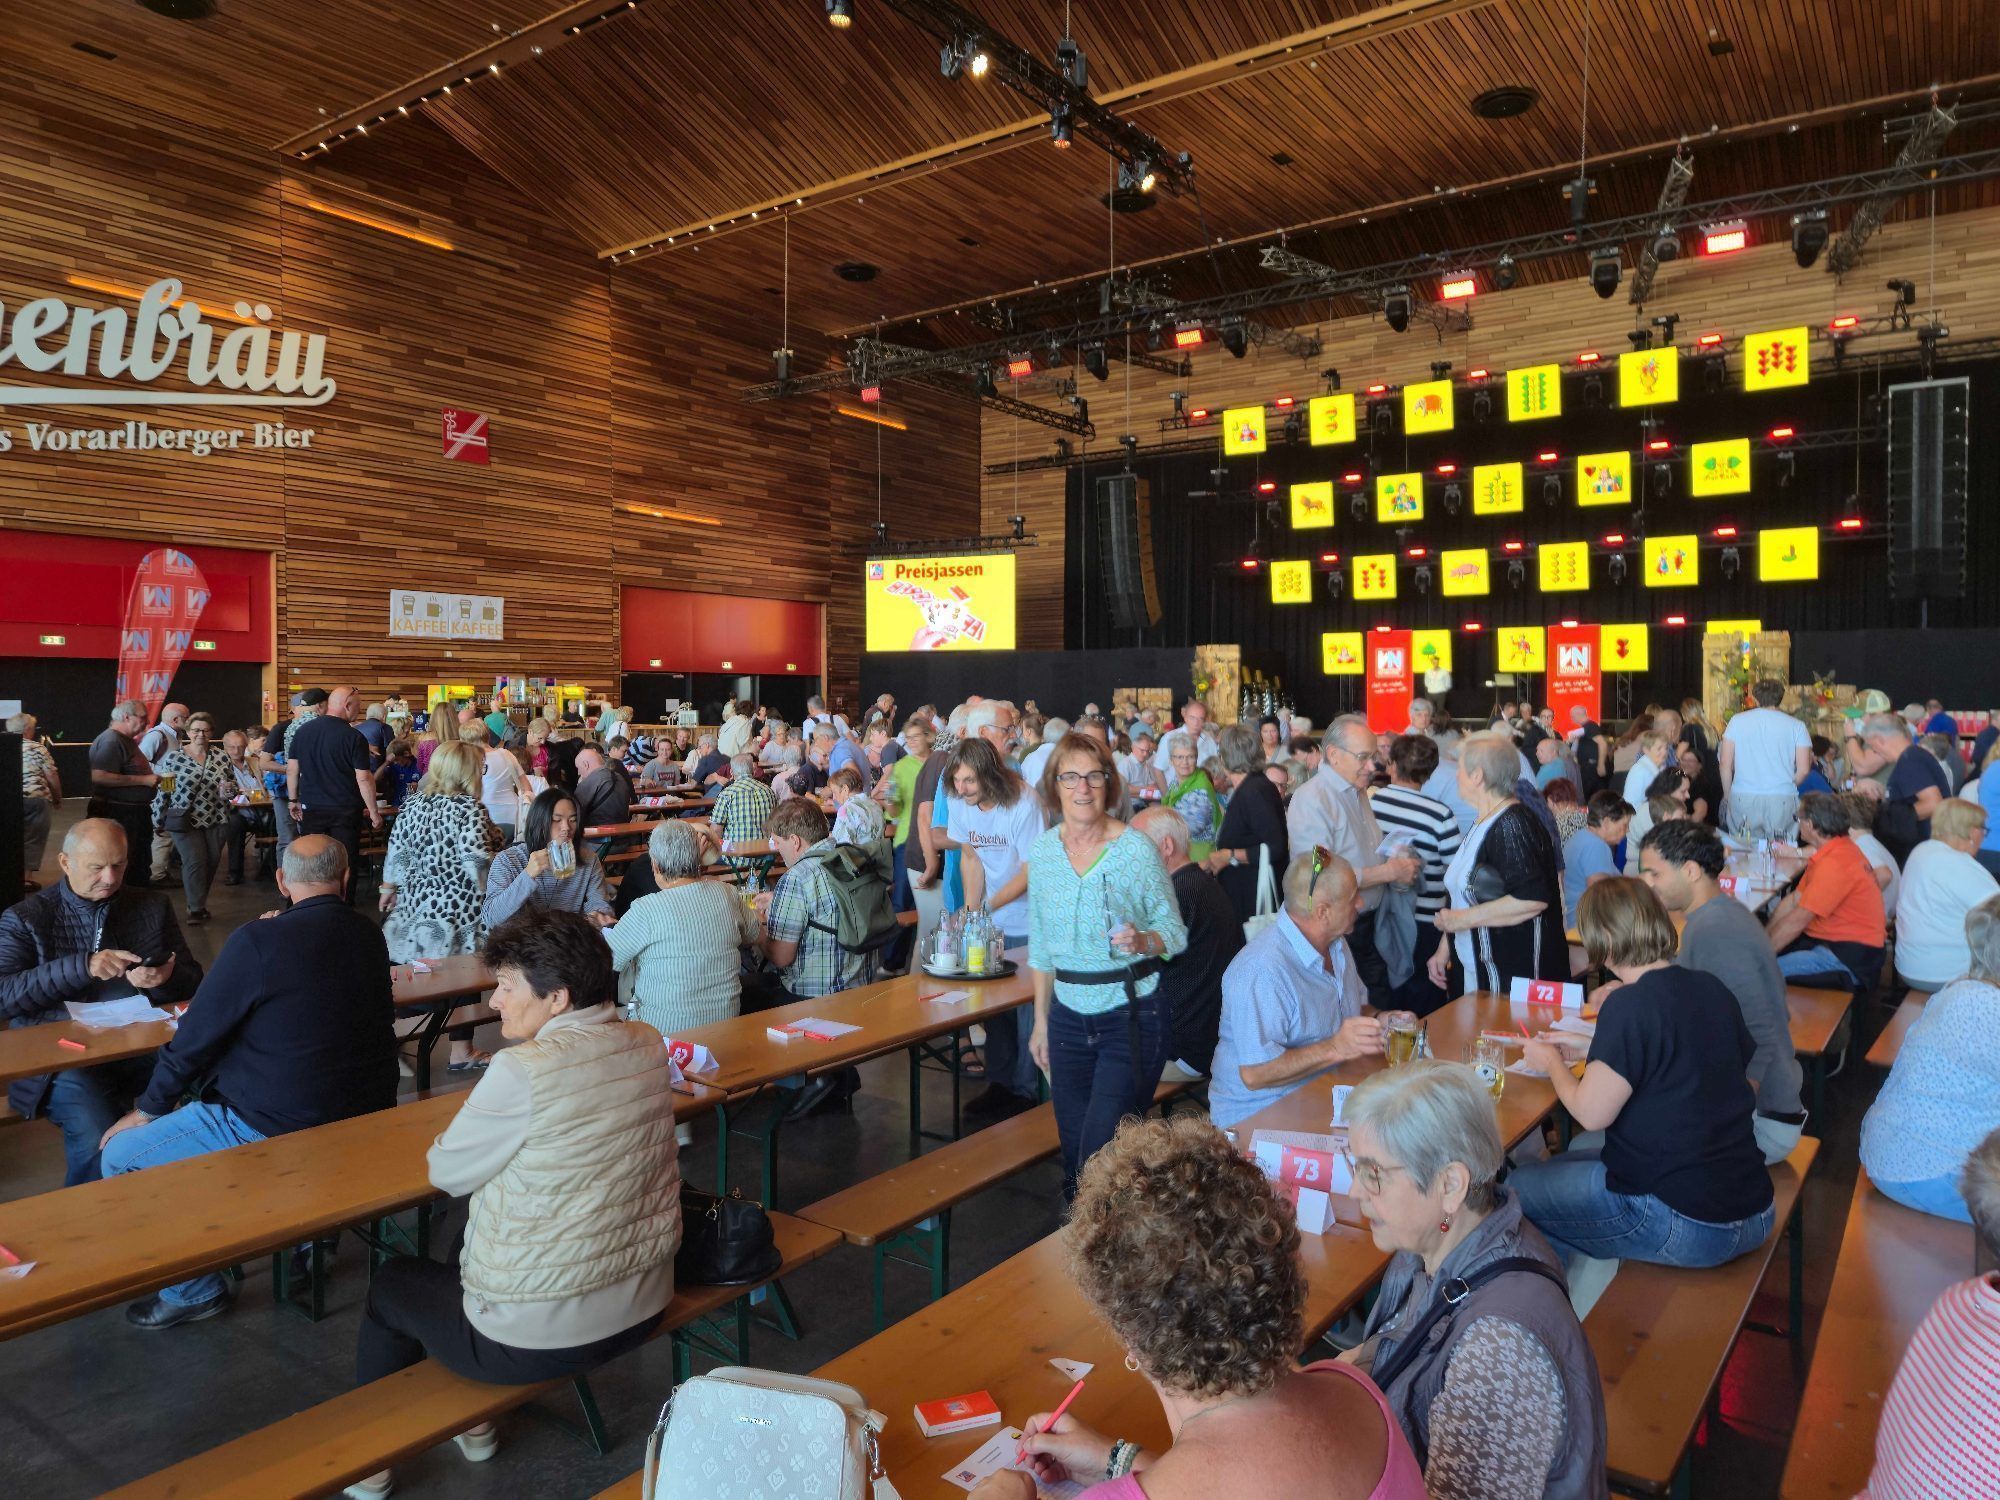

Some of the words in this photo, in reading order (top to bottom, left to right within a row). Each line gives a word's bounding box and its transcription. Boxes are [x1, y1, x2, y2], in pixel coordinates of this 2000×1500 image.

[0, 278, 337, 405] enbräu
[25, 421, 243, 456] Vorarlberger
[254, 422, 315, 449] Bier
[895, 562, 983, 581] Preisjassen
[143, 585, 171, 608] VN
[393, 618, 447, 634] KAFFEE
[451, 620, 503, 636] KAFFEE
[122, 630, 149, 651] VN
[164, 630, 192, 651] VN
[1377, 650, 1402, 669] VN
[1559, 646, 1588, 668] VN
[143, 672, 170, 693] VN
[1537, 985, 1555, 1002] 72
[1293, 1156, 1320, 1182] 73
